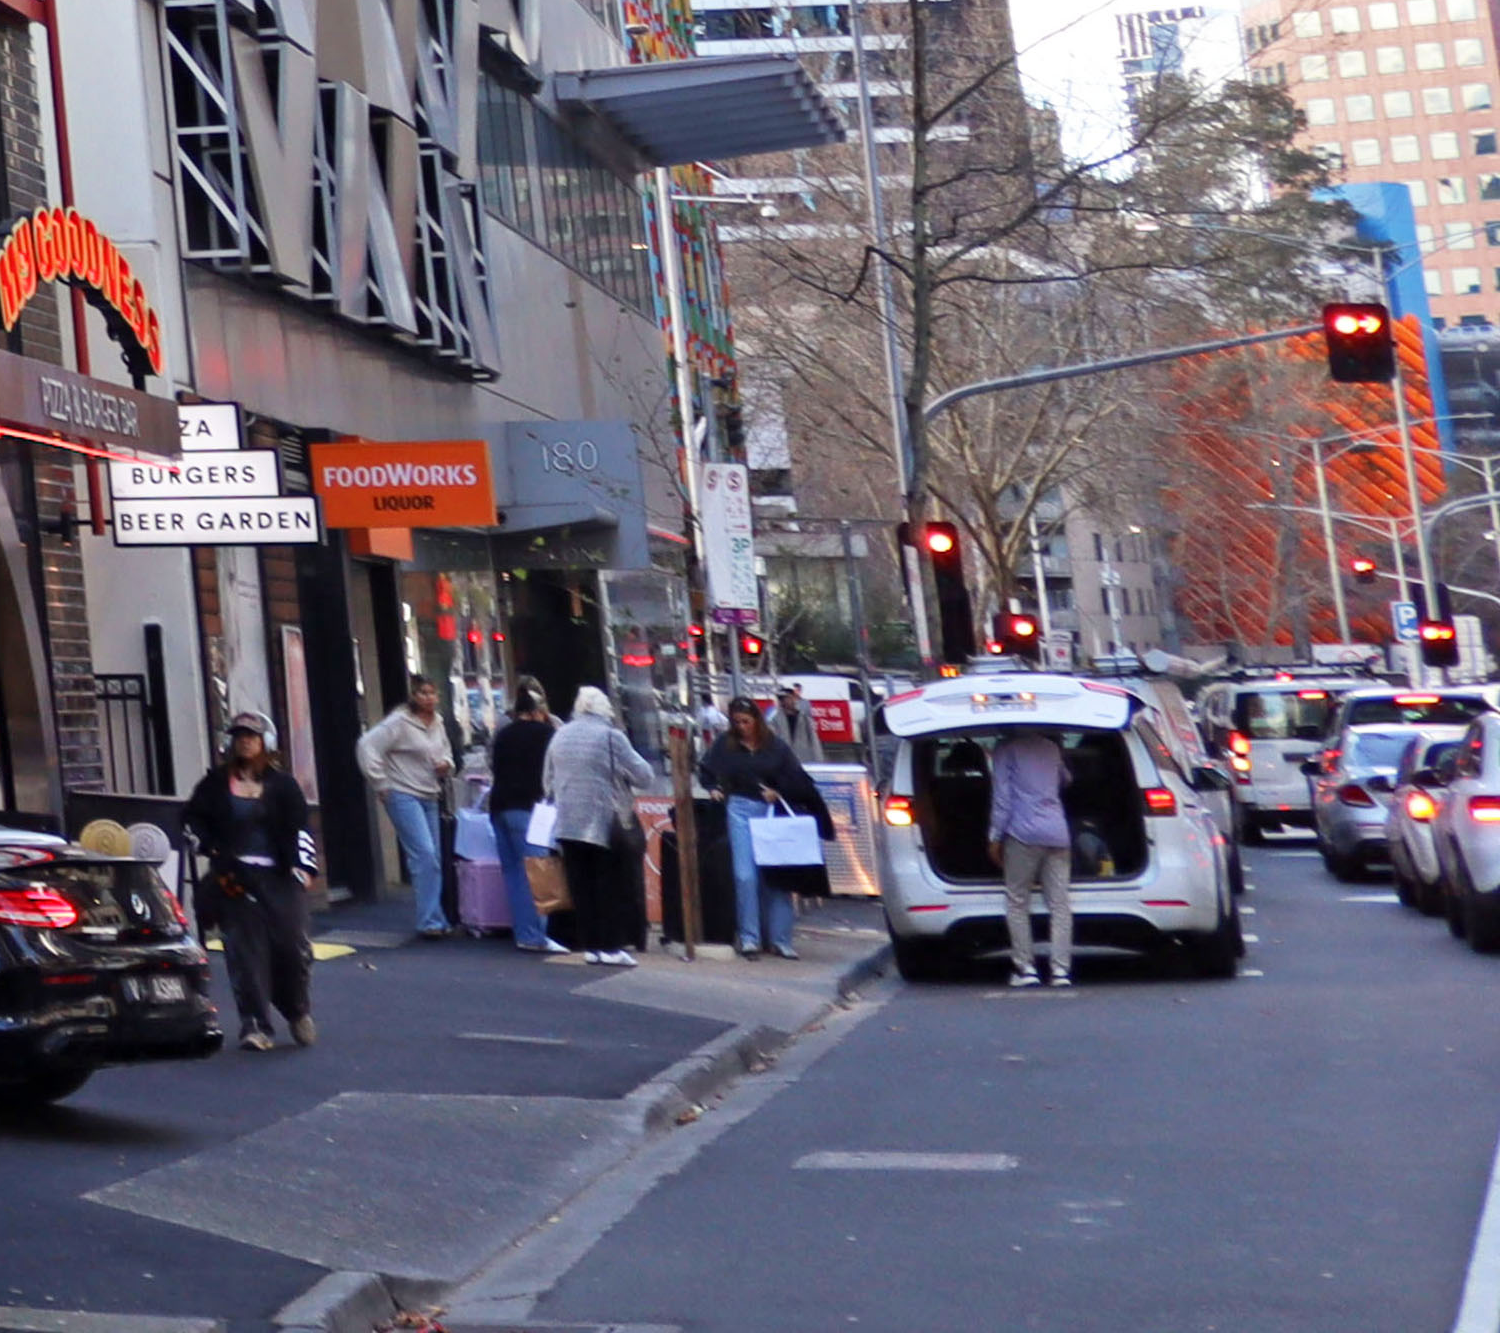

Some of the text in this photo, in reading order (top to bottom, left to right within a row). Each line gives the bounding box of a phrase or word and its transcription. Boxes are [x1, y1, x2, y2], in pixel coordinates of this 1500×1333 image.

[180, 419, 213, 438] ZA
[541, 440, 598, 472] 180
[131, 466, 256, 485] BURGERS
[323, 462, 478, 488] FOODWORKS
[373, 495, 435, 512] LIQUOR
[120, 510, 312, 531] BEER GARDEN
